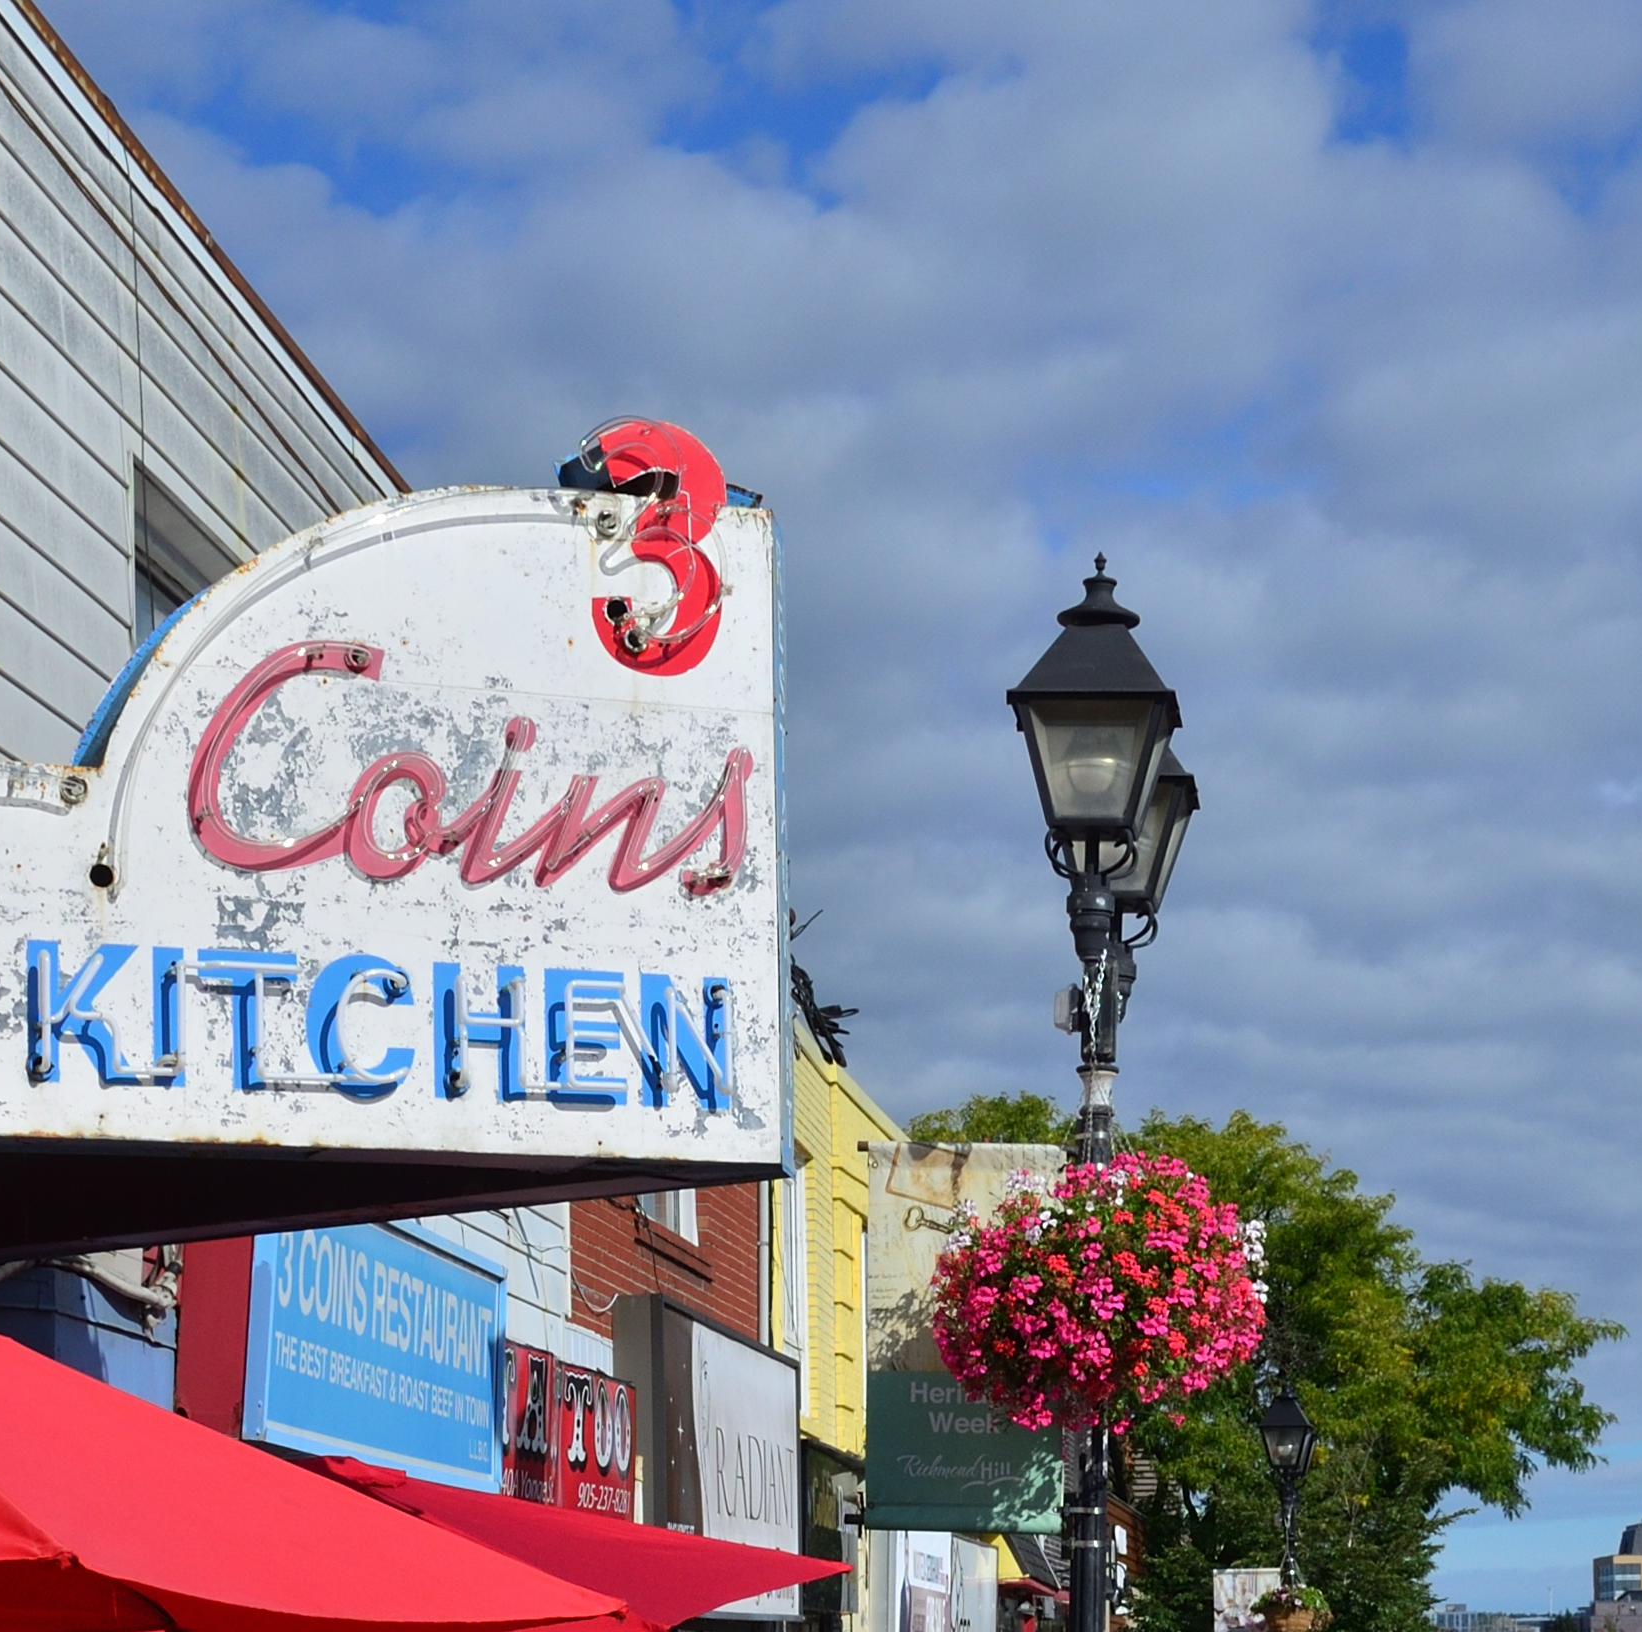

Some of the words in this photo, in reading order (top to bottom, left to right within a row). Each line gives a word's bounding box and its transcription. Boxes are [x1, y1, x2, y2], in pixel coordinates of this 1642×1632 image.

[582, 418, 727, 677] 3
[188, 640, 755, 897] Coins
[26, 936, 737, 1114] KITCHEN
[278, 1231, 294, 1309] 3
[298, 1230, 368, 1337] COINS
[371, 1260, 494, 1379] RESTAURANT
[275, 1330, 297, 1372] THE
[298, 1339, 328, 1381] BEST
[328, 1350, 389, 1400] BREAKFAST
[389, 1371, 398, 1402] &
[398, 1376, 431, 1413] ROAST
[431, 1386, 454, 1419] BEEF
[454, 1393, 465, 1421] IN
[465, 1396, 490, 1430] TOWN
[929, 1411, 1000, 1435] Week
[576, 1481, 631, 1515] 905-237-8281
[715, 1426, 794, 1530] RADIANT
[897, 1454, 980, 1478] Richmond
[980, 1460, 1011, 1480] Hill
